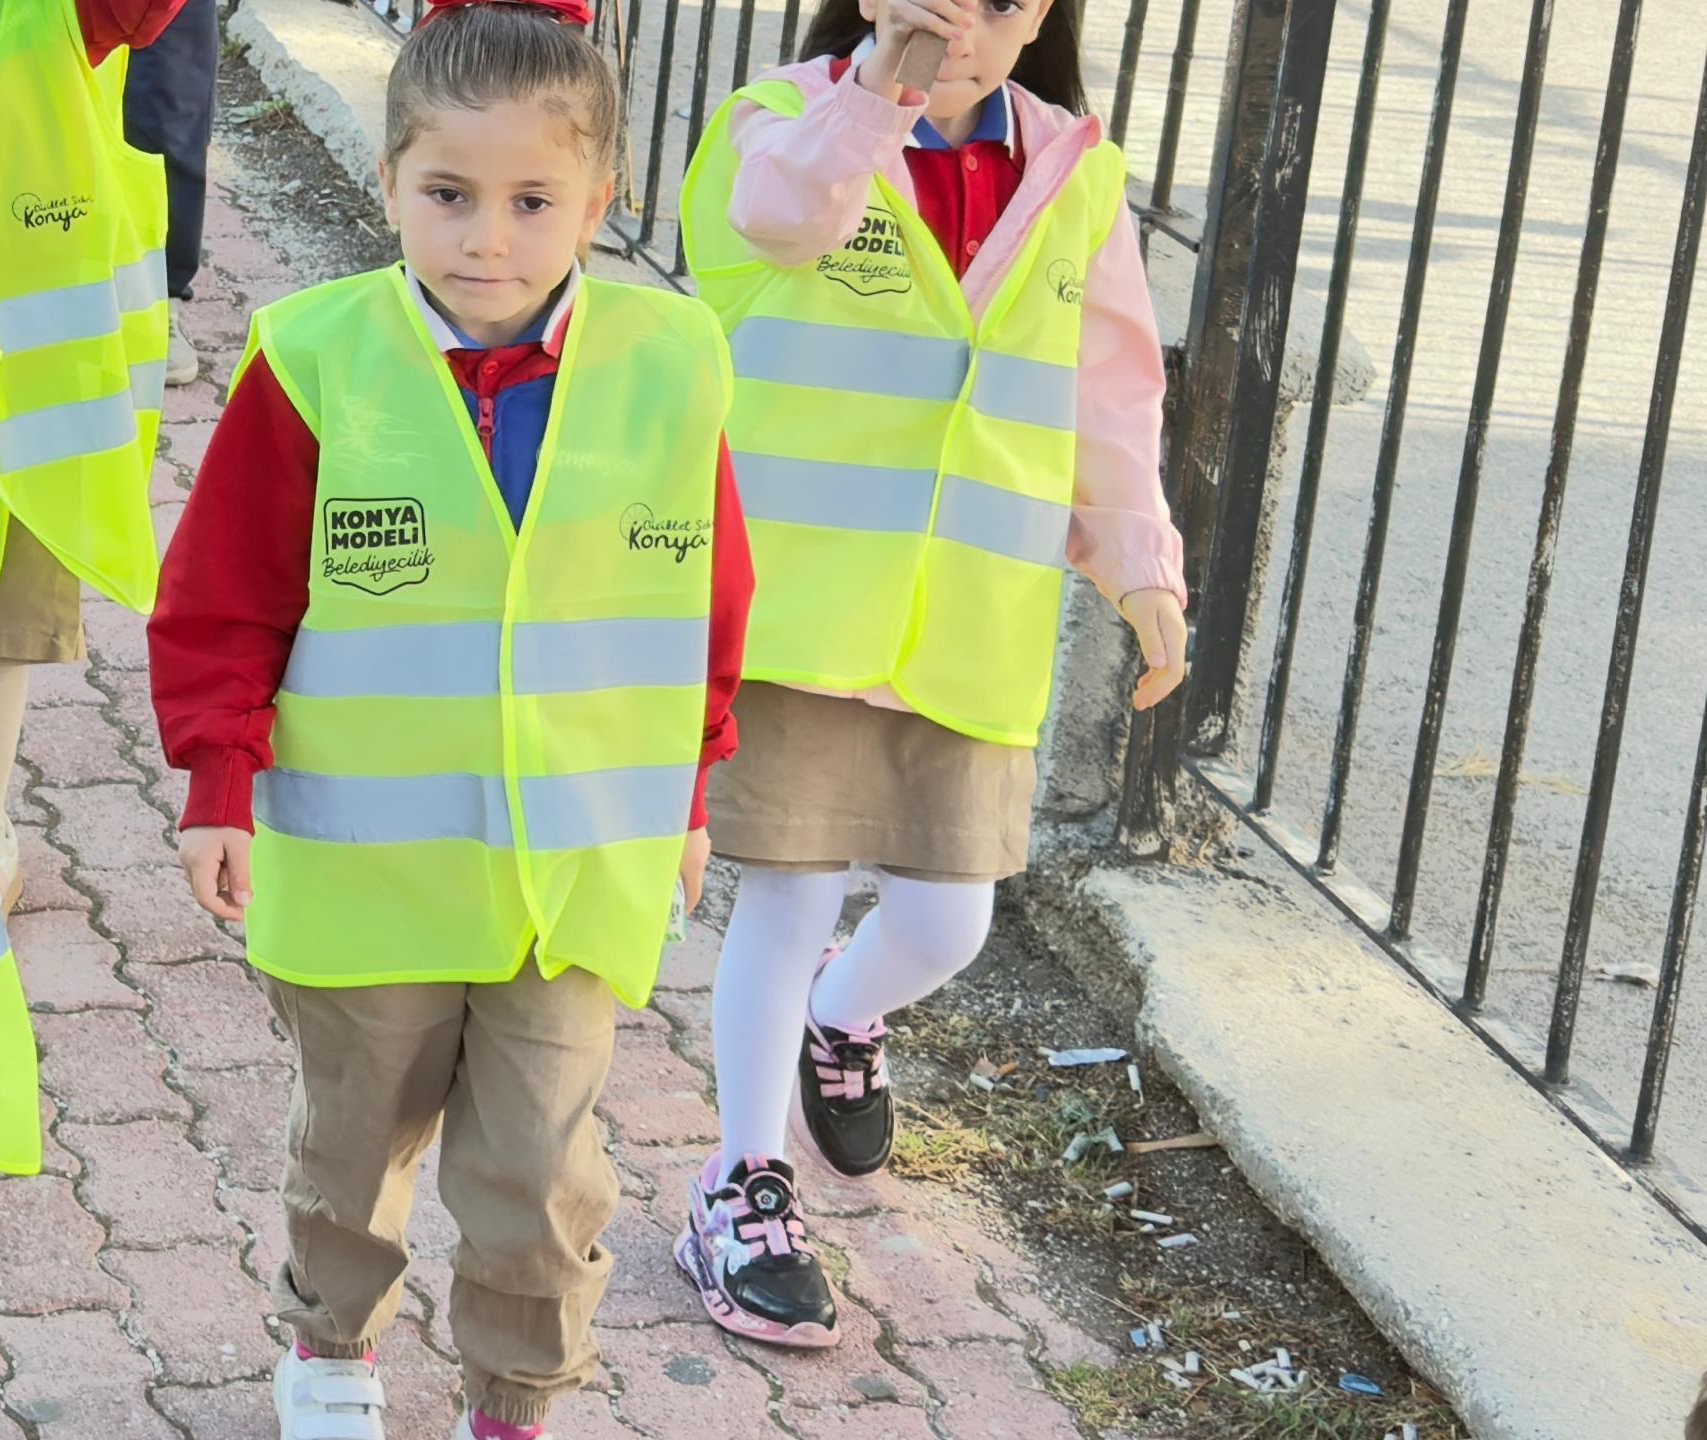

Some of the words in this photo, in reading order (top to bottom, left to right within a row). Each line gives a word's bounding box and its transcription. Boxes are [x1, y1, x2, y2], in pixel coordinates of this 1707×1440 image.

[24, 205, 87, 232] Konya
[331, 505, 418, 530] KONYA
[629, 520, 708, 564] Konya
[323, 548, 435, 581] Belediyecilik
